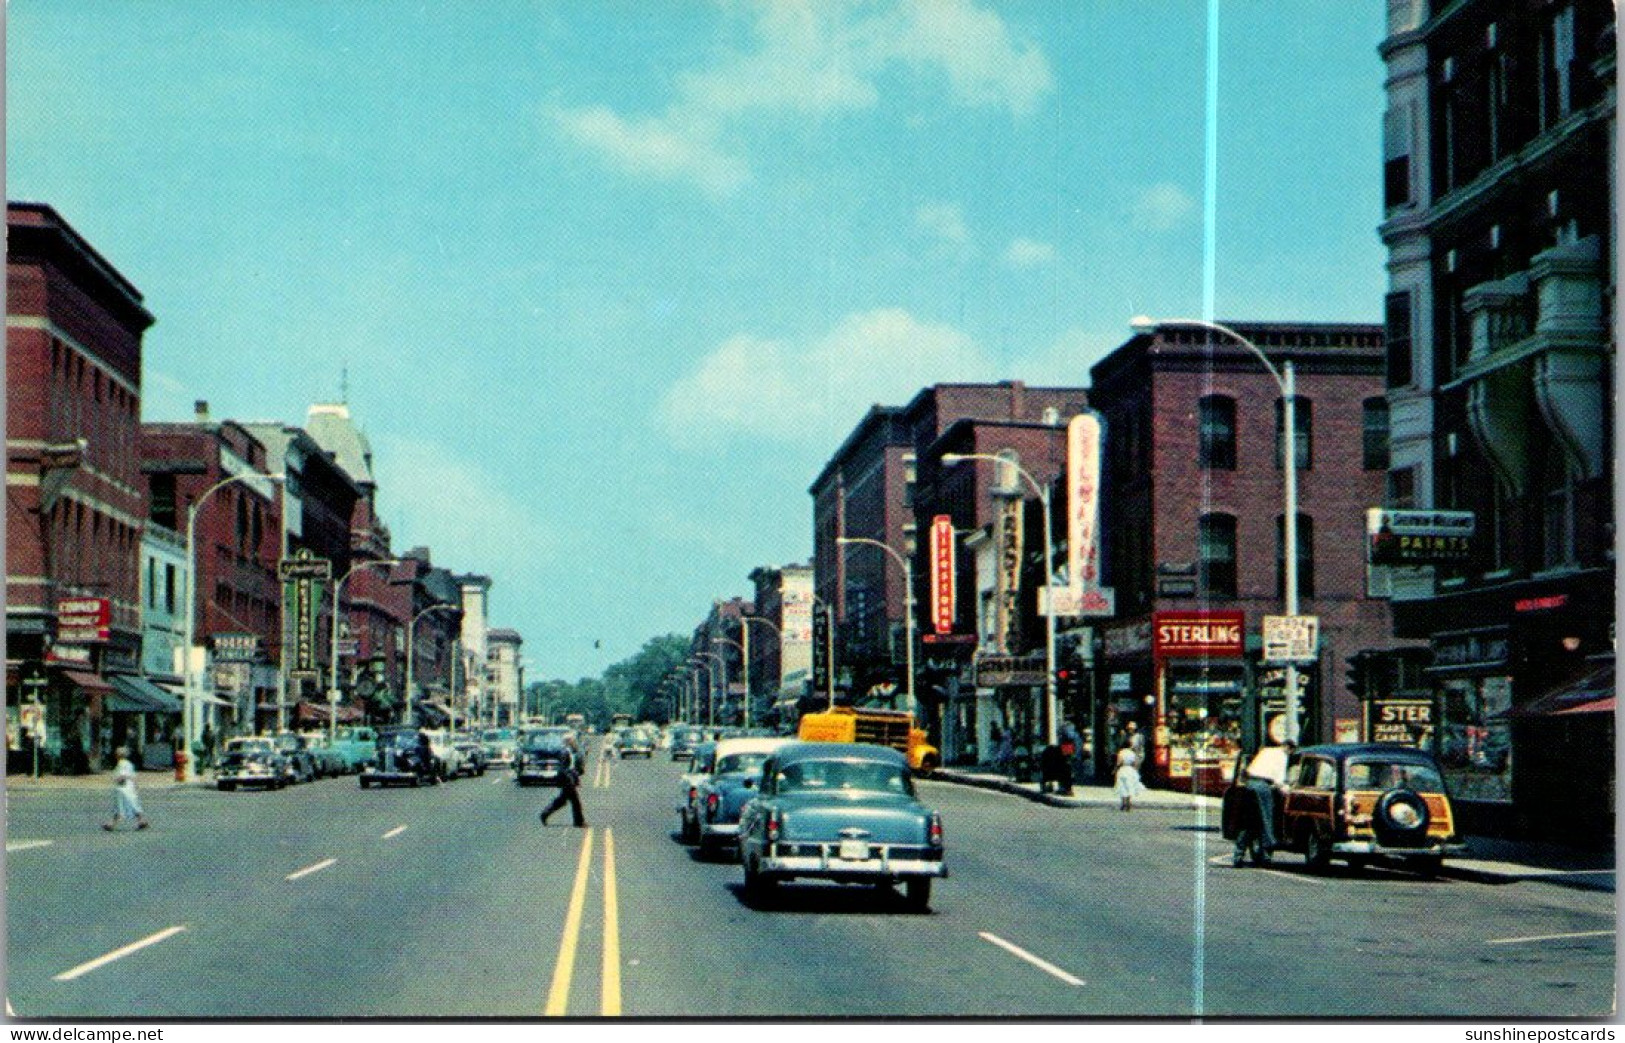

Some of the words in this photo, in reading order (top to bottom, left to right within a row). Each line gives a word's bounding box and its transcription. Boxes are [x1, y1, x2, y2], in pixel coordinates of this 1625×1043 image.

[1401, 537, 1468, 549] PAINTS
[1159, 625, 1240, 644] STERLING
[1381, 705, 1431, 721] STER
